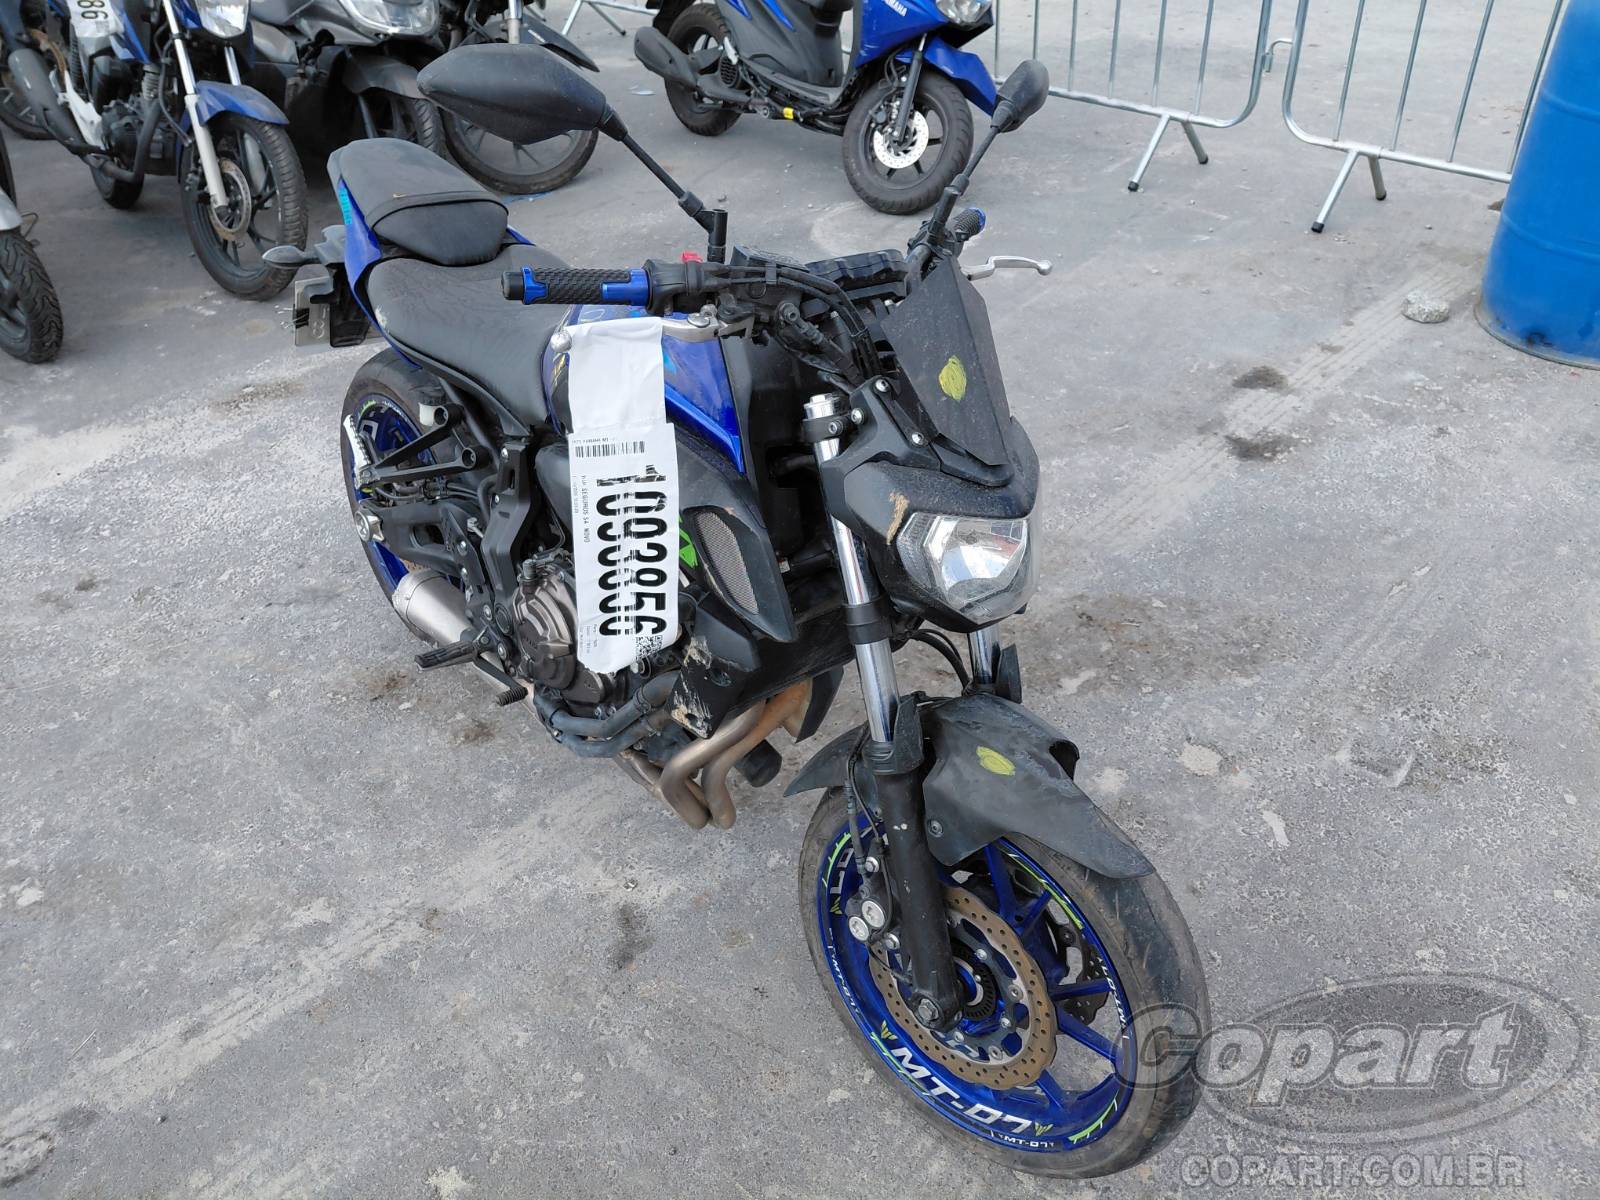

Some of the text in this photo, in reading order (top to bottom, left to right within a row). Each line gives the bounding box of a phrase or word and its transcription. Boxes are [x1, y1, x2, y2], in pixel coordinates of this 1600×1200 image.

[596, 464, 667, 636] 1093856
[890, 1047, 1033, 1134] MT-07
[1003, 1135, 1050, 1148] MT-07
